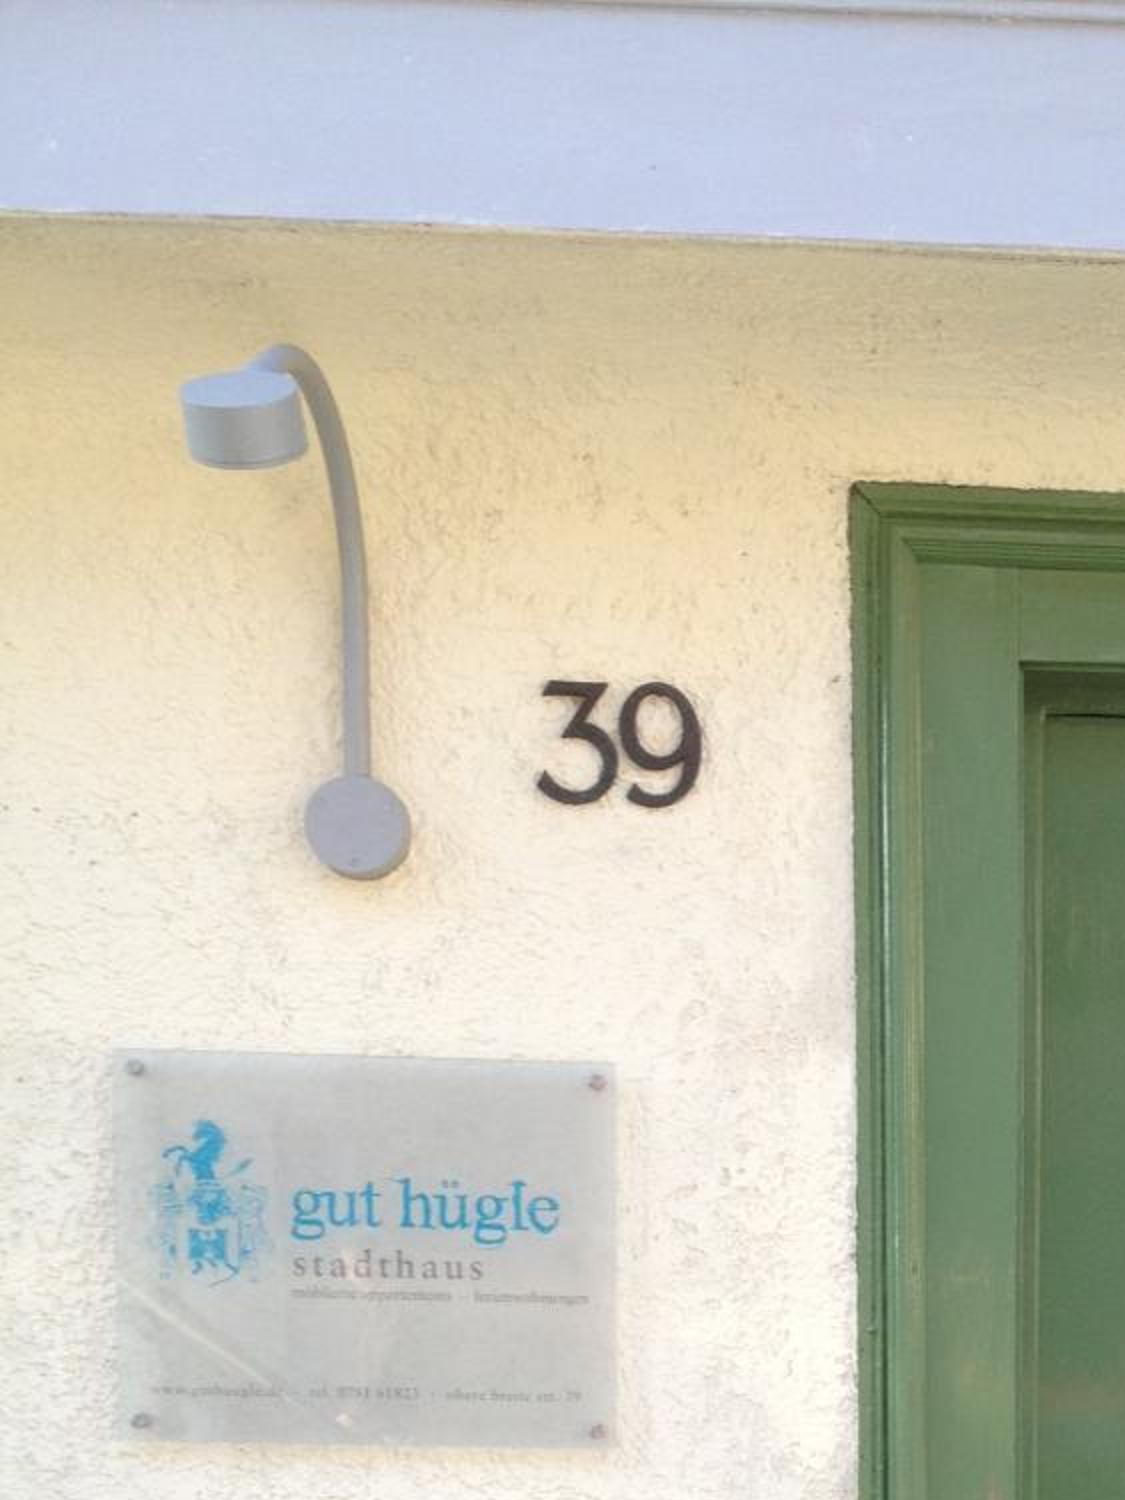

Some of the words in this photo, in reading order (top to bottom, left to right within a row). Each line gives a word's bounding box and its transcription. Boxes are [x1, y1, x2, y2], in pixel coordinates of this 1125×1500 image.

[537, 680, 702, 808] 39
[291, 1181, 381, 1240] gut
[397, 1177, 560, 1245] hügle
[292, 1249, 484, 1281] stadthaus
